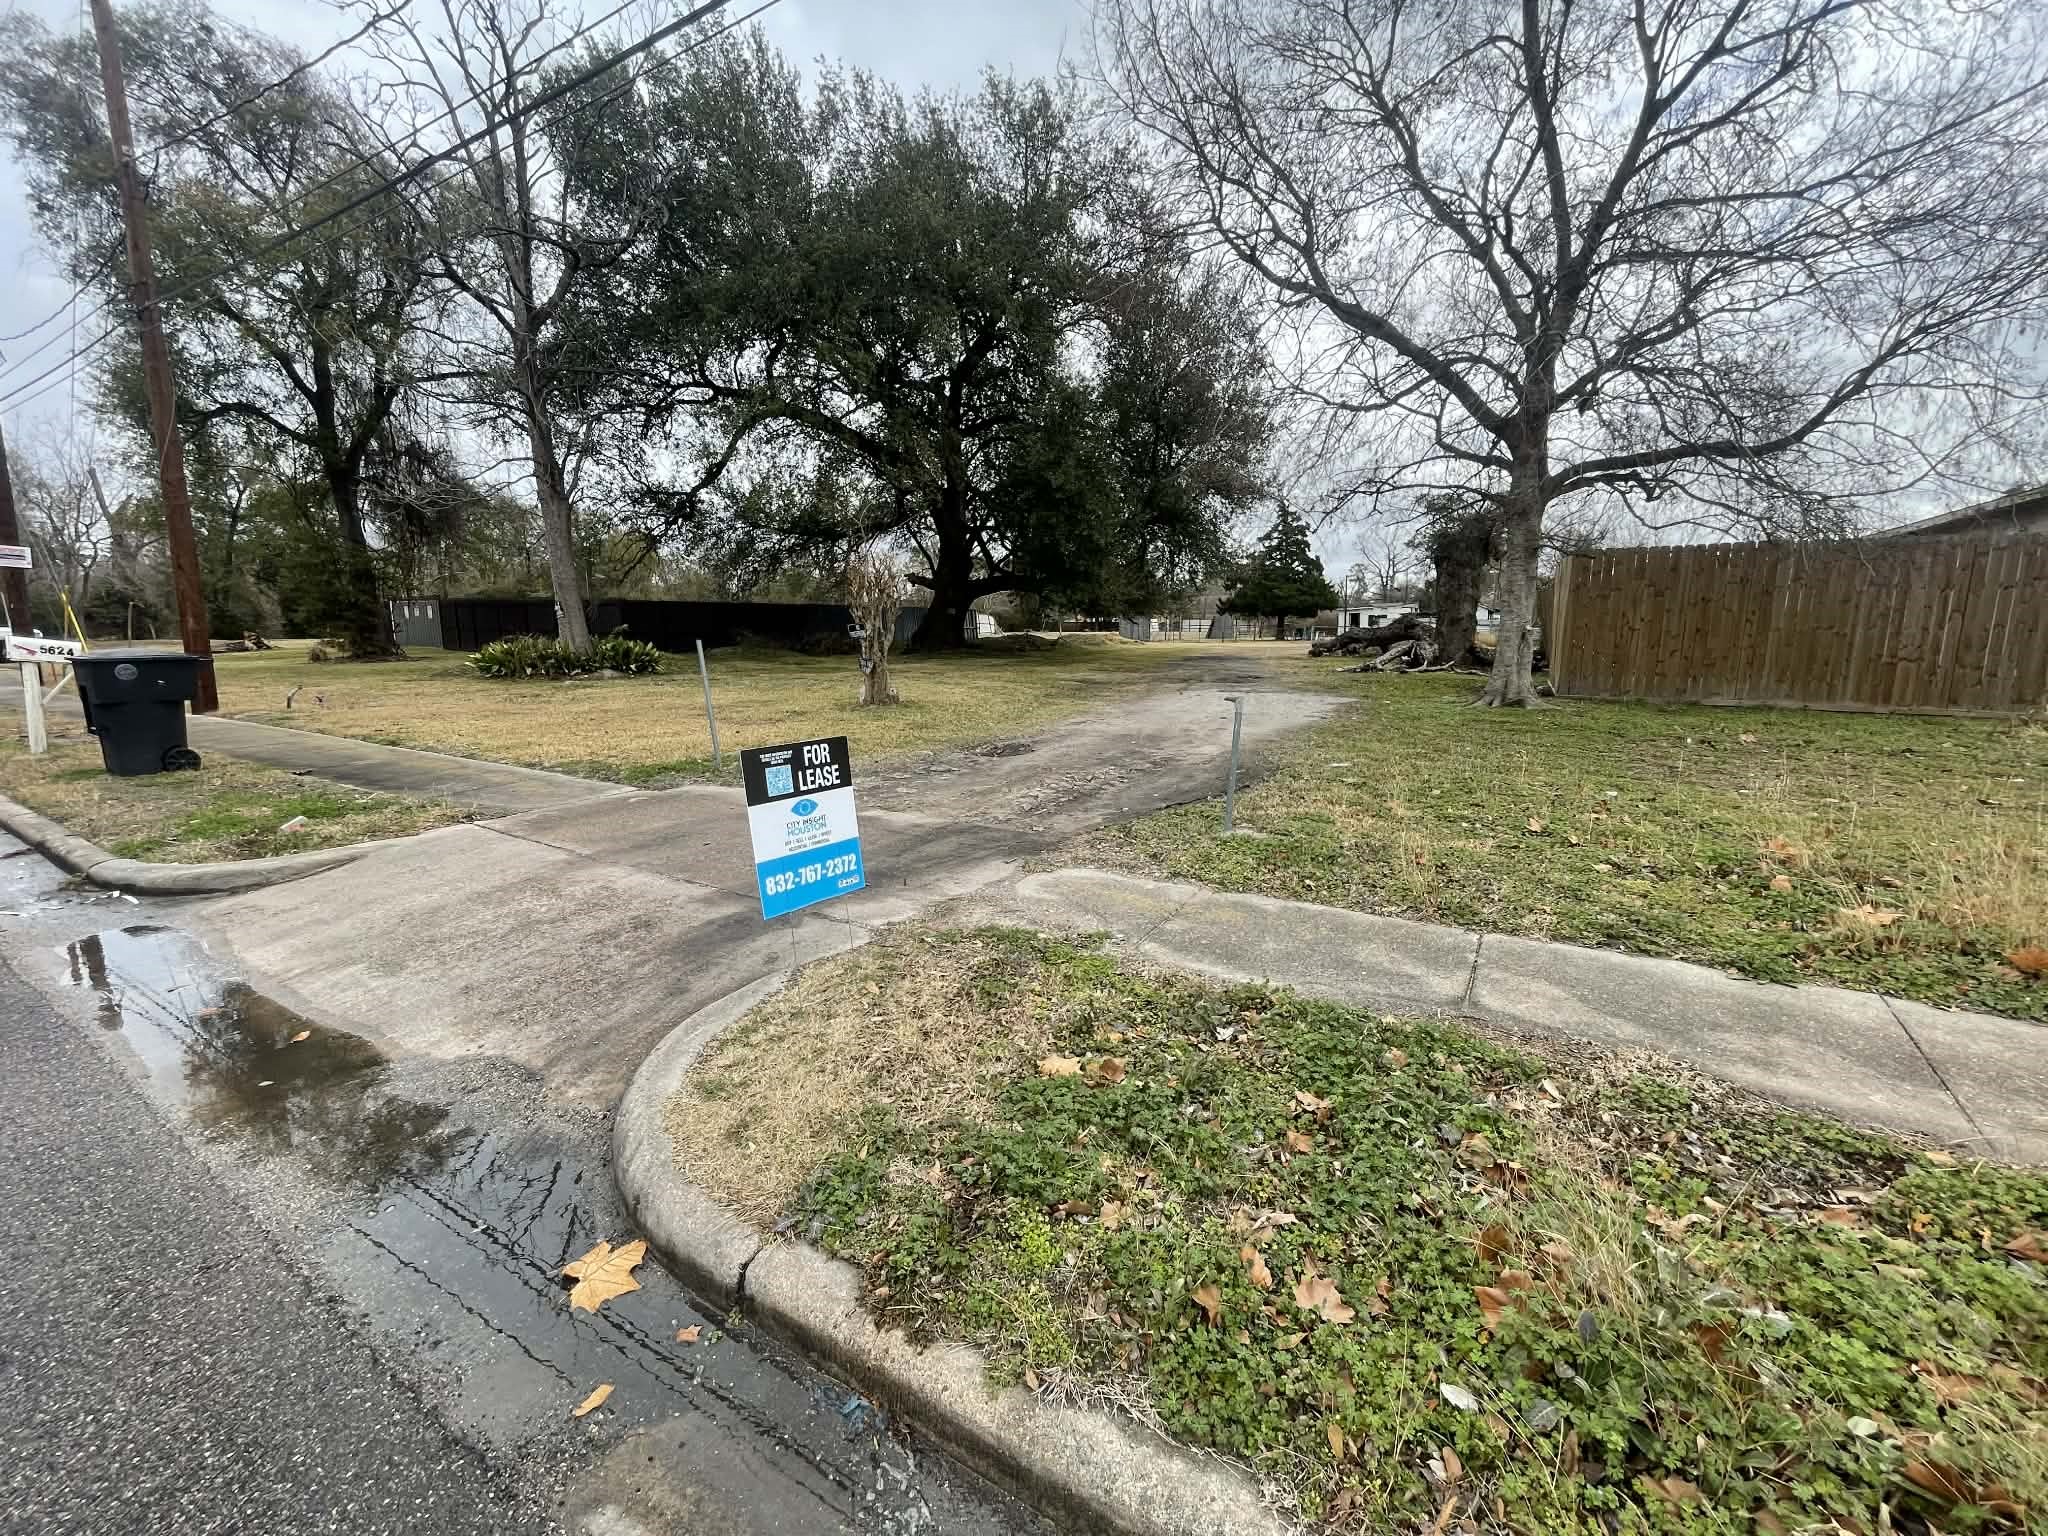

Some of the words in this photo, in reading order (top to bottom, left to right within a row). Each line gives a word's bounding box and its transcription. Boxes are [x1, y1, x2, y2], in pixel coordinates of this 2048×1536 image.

[40, 645, 74, 656] 5624
[803, 743, 831, 767] FOR
[798, 764, 841, 791] LEASE
[786, 820, 801, 830] CITY
[802, 814, 827, 826] INSIGHT
[787, 820, 827, 837] HOUSTON
[765, 853, 858, 896] 832-767-2372
